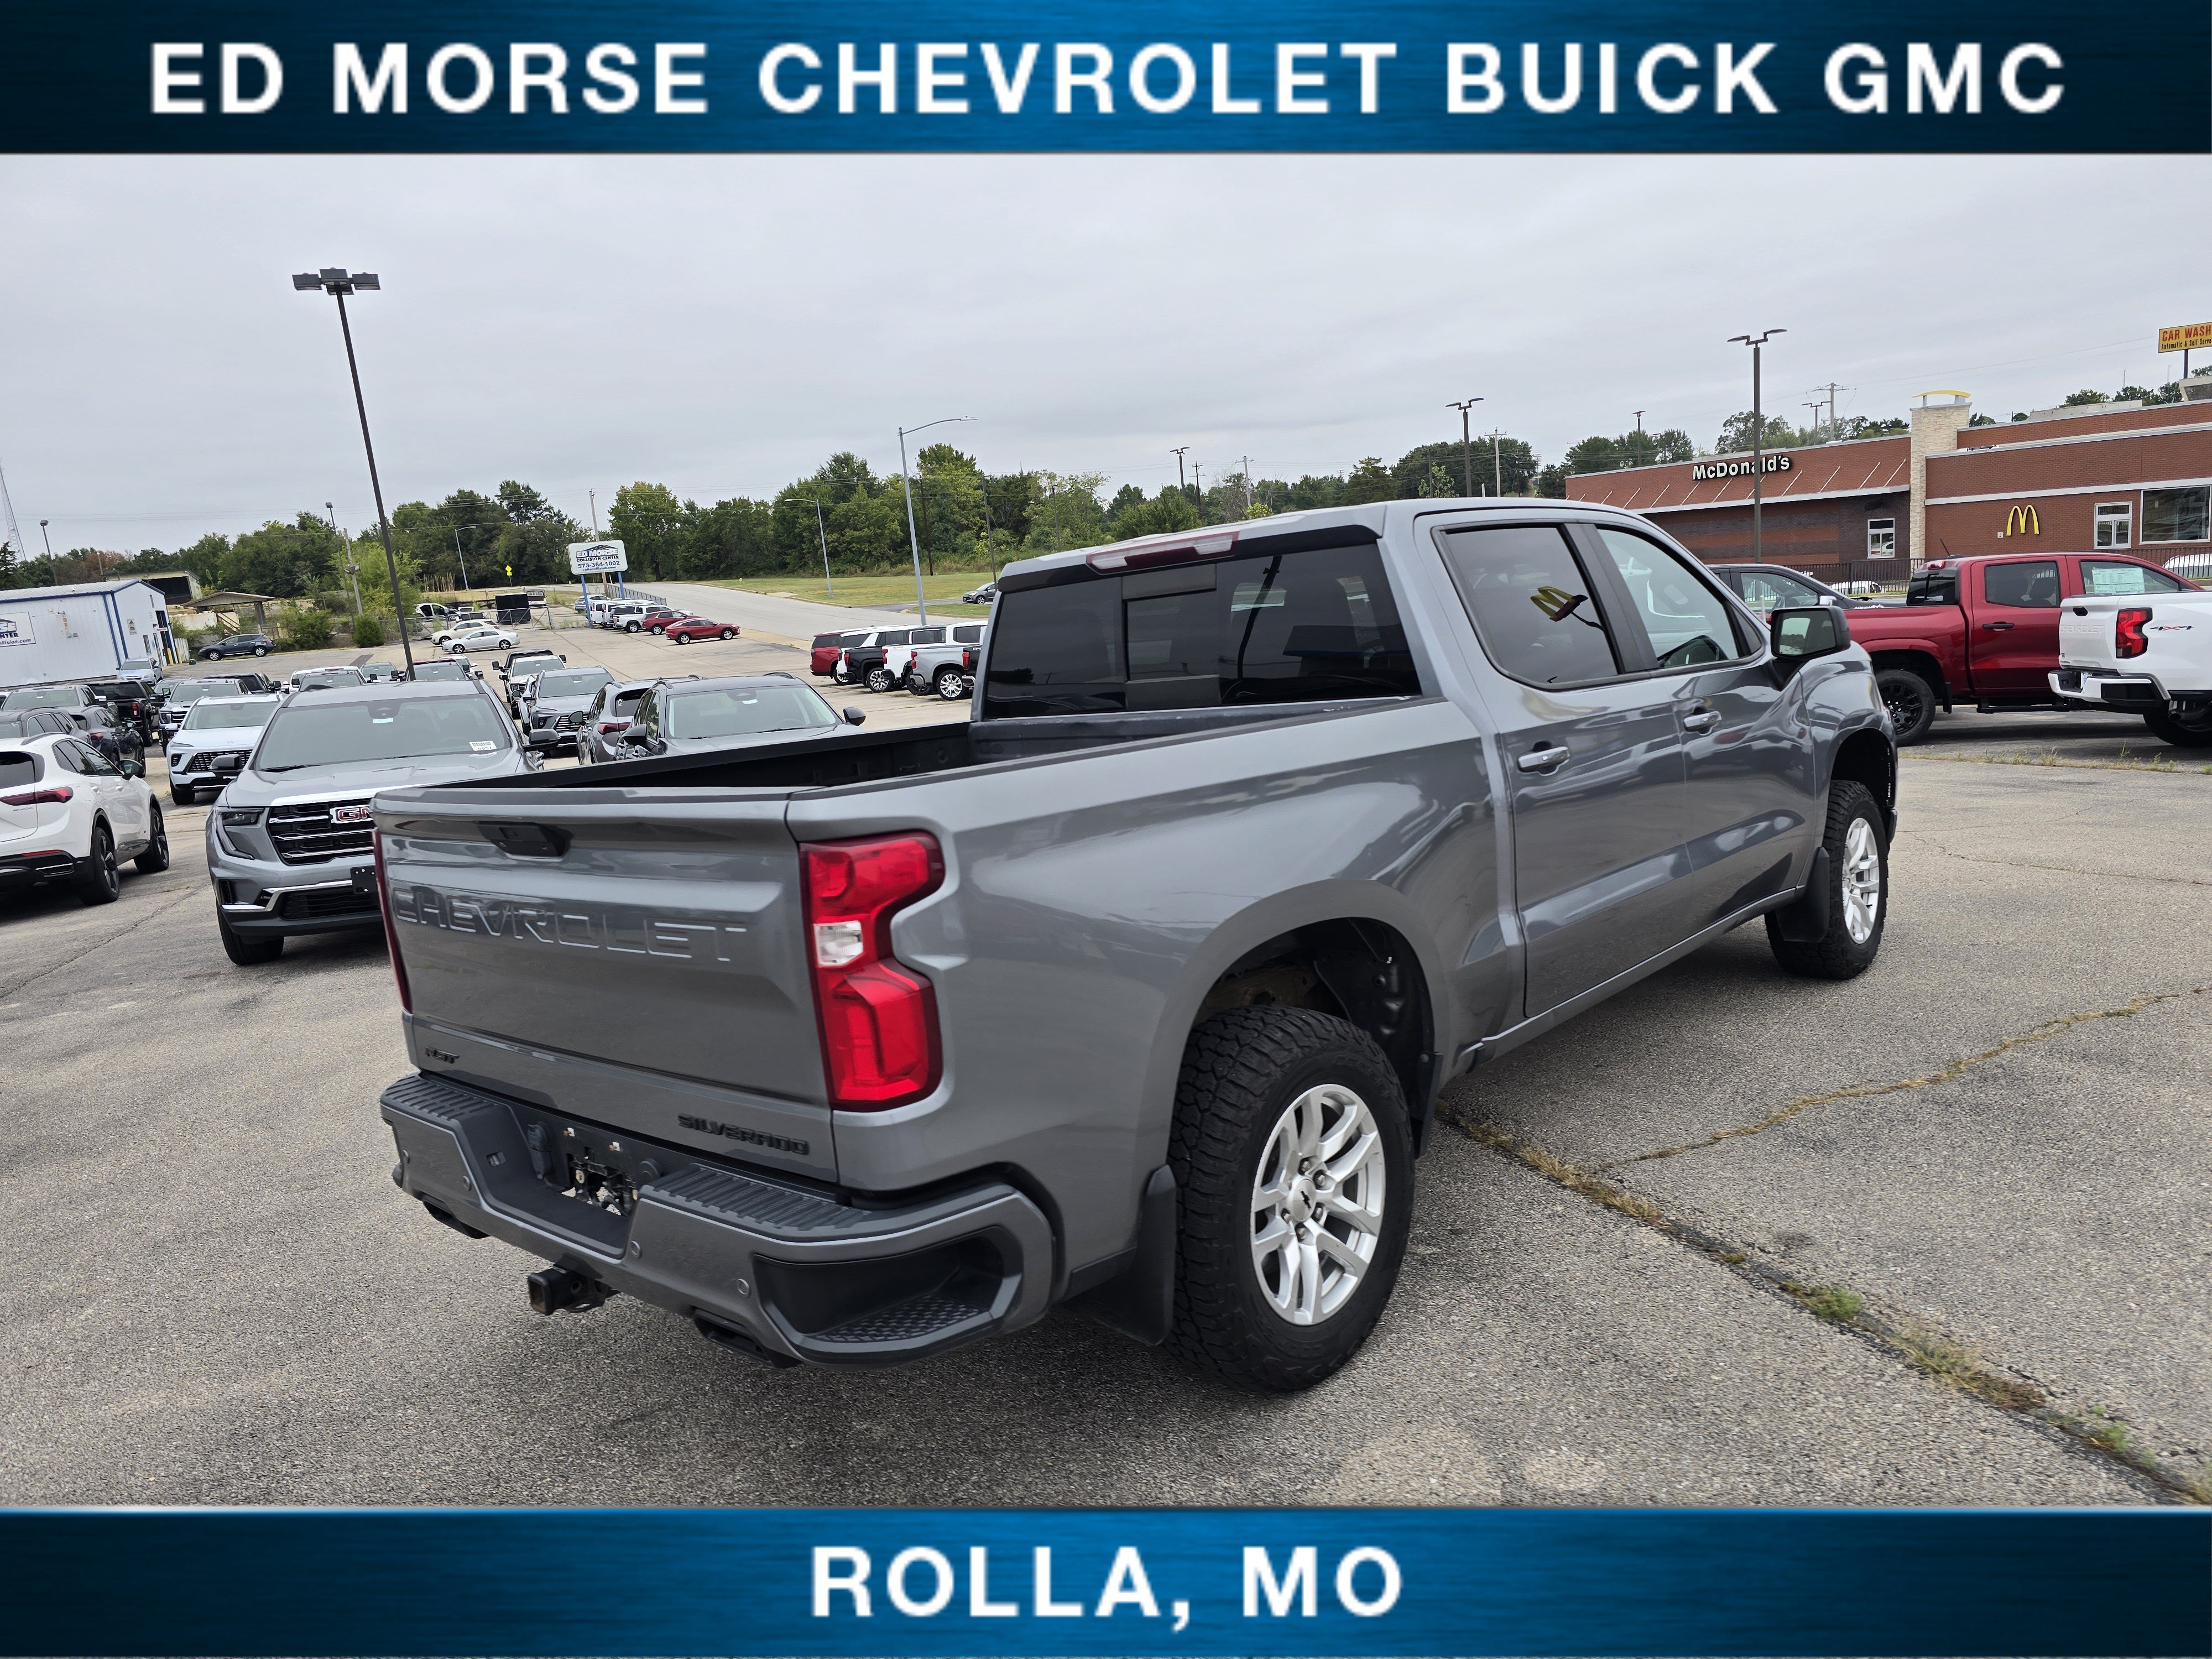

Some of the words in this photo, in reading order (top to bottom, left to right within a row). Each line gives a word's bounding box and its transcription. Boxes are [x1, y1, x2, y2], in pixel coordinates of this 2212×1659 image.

[2162, 329, 2180, 342] CAR
[2184, 325, 2211, 338] WASH
[2161, 341, 2183, 350] Automatic
[576, 550, 588, 558] ED
[588, 547, 618, 557] MORSE
[578, 560, 620, 568] 573-364-1002
[393, 888, 747, 962] CHEVROLET
[677, 1113, 810, 1156] SILVERADO
